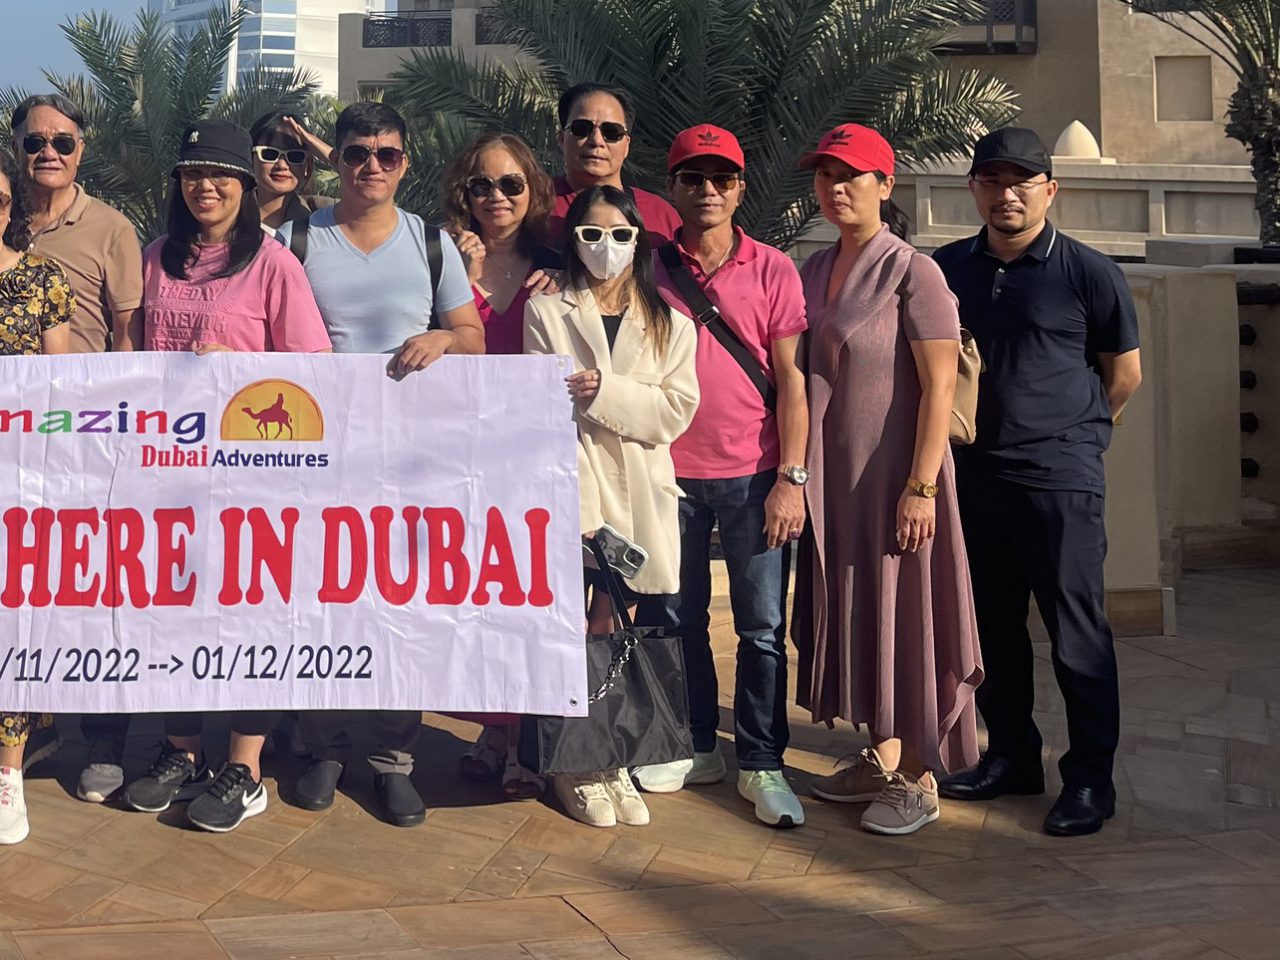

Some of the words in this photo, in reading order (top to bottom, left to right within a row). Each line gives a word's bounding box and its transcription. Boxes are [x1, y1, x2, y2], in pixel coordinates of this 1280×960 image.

[141, 444, 209, 469] Dubai
[211, 449, 329, 468] Adventures
[0, 506, 198, 610] HERE
[218, 506, 300, 607] IN
[318, 505, 554, 608] DUBAI
[191, 644, 374, 681] 01/12/2022
